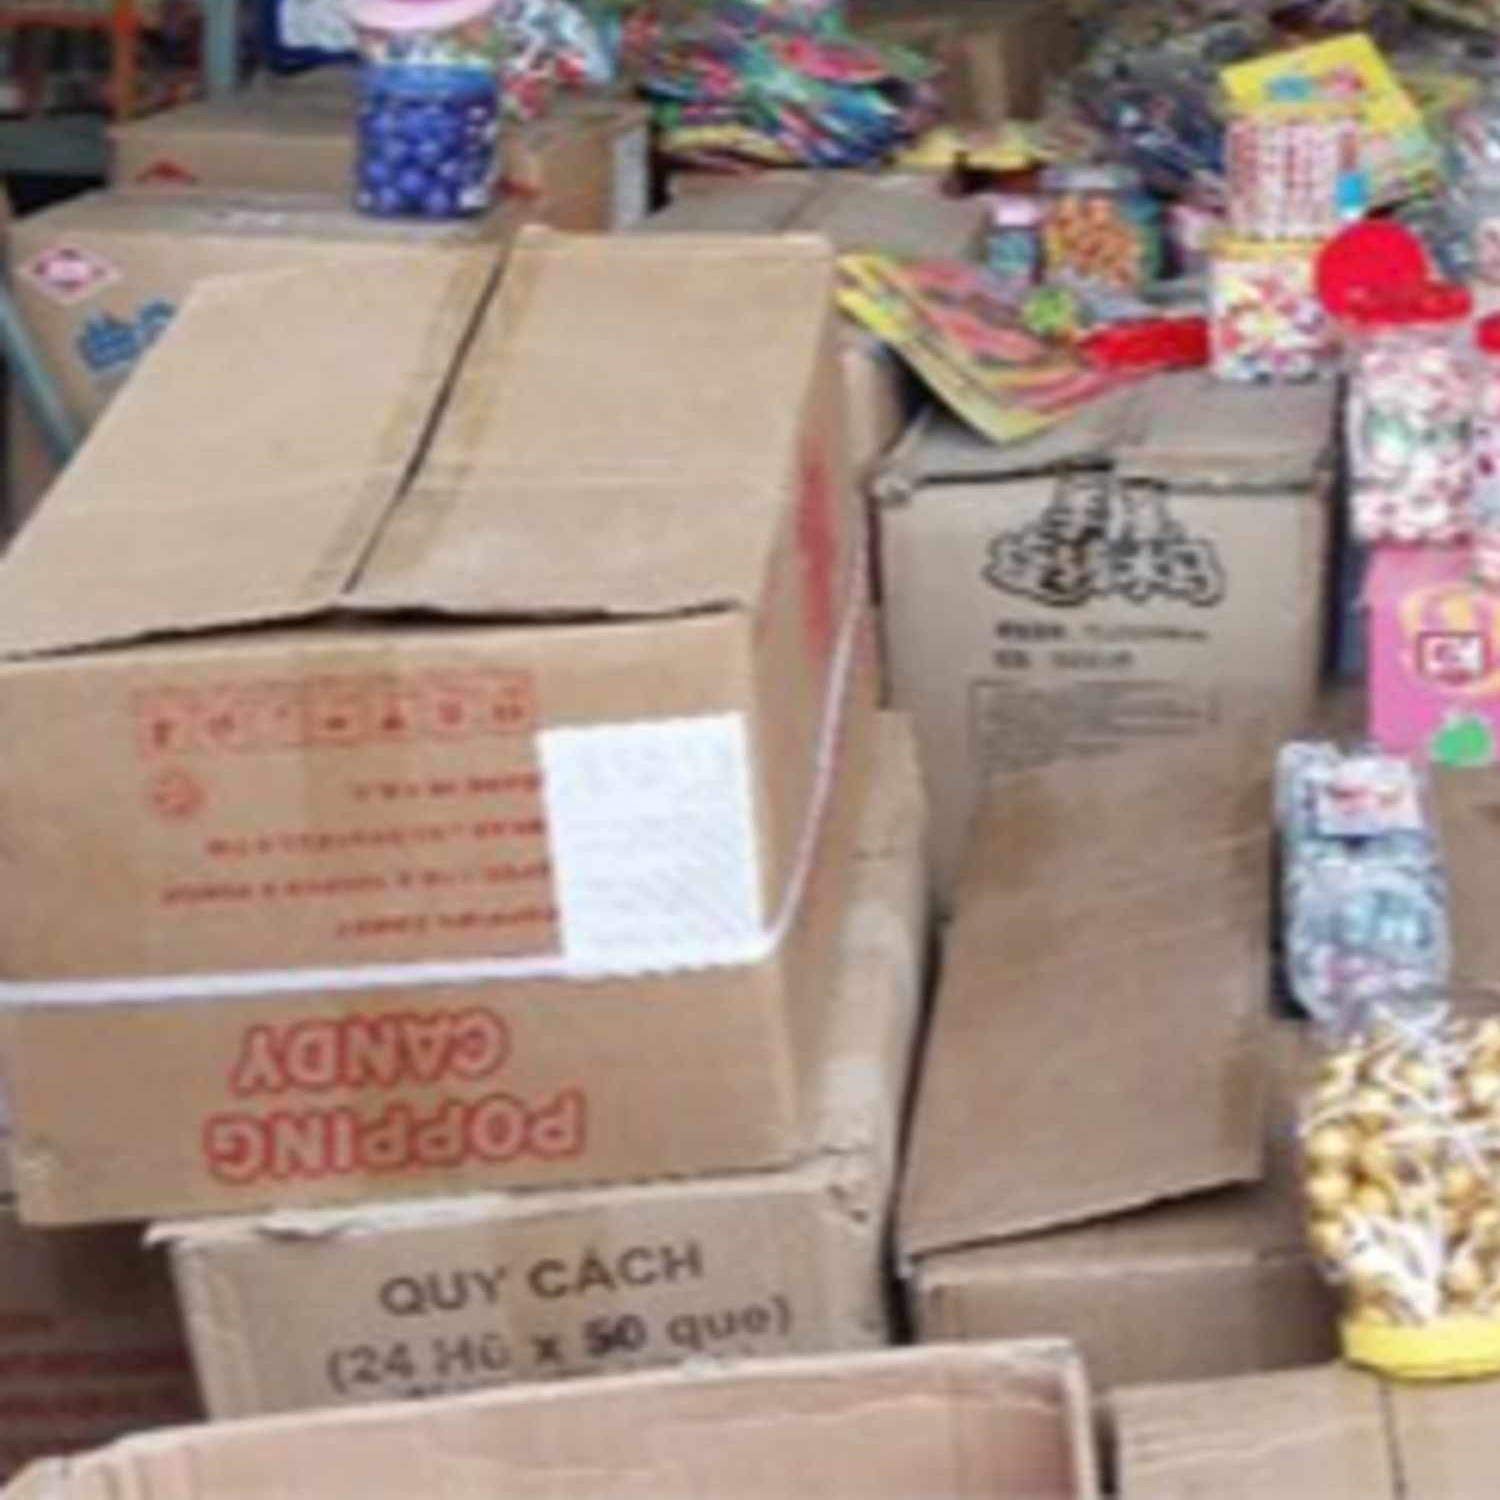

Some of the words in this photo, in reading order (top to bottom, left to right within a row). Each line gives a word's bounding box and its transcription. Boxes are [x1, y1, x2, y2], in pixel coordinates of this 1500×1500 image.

[231, 1007, 509, 1094] CANDY
[205, 1090, 584, 1183] POPPING
[377, 1269, 506, 1318] QUY
[326, 1342, 415, 1394] (24
